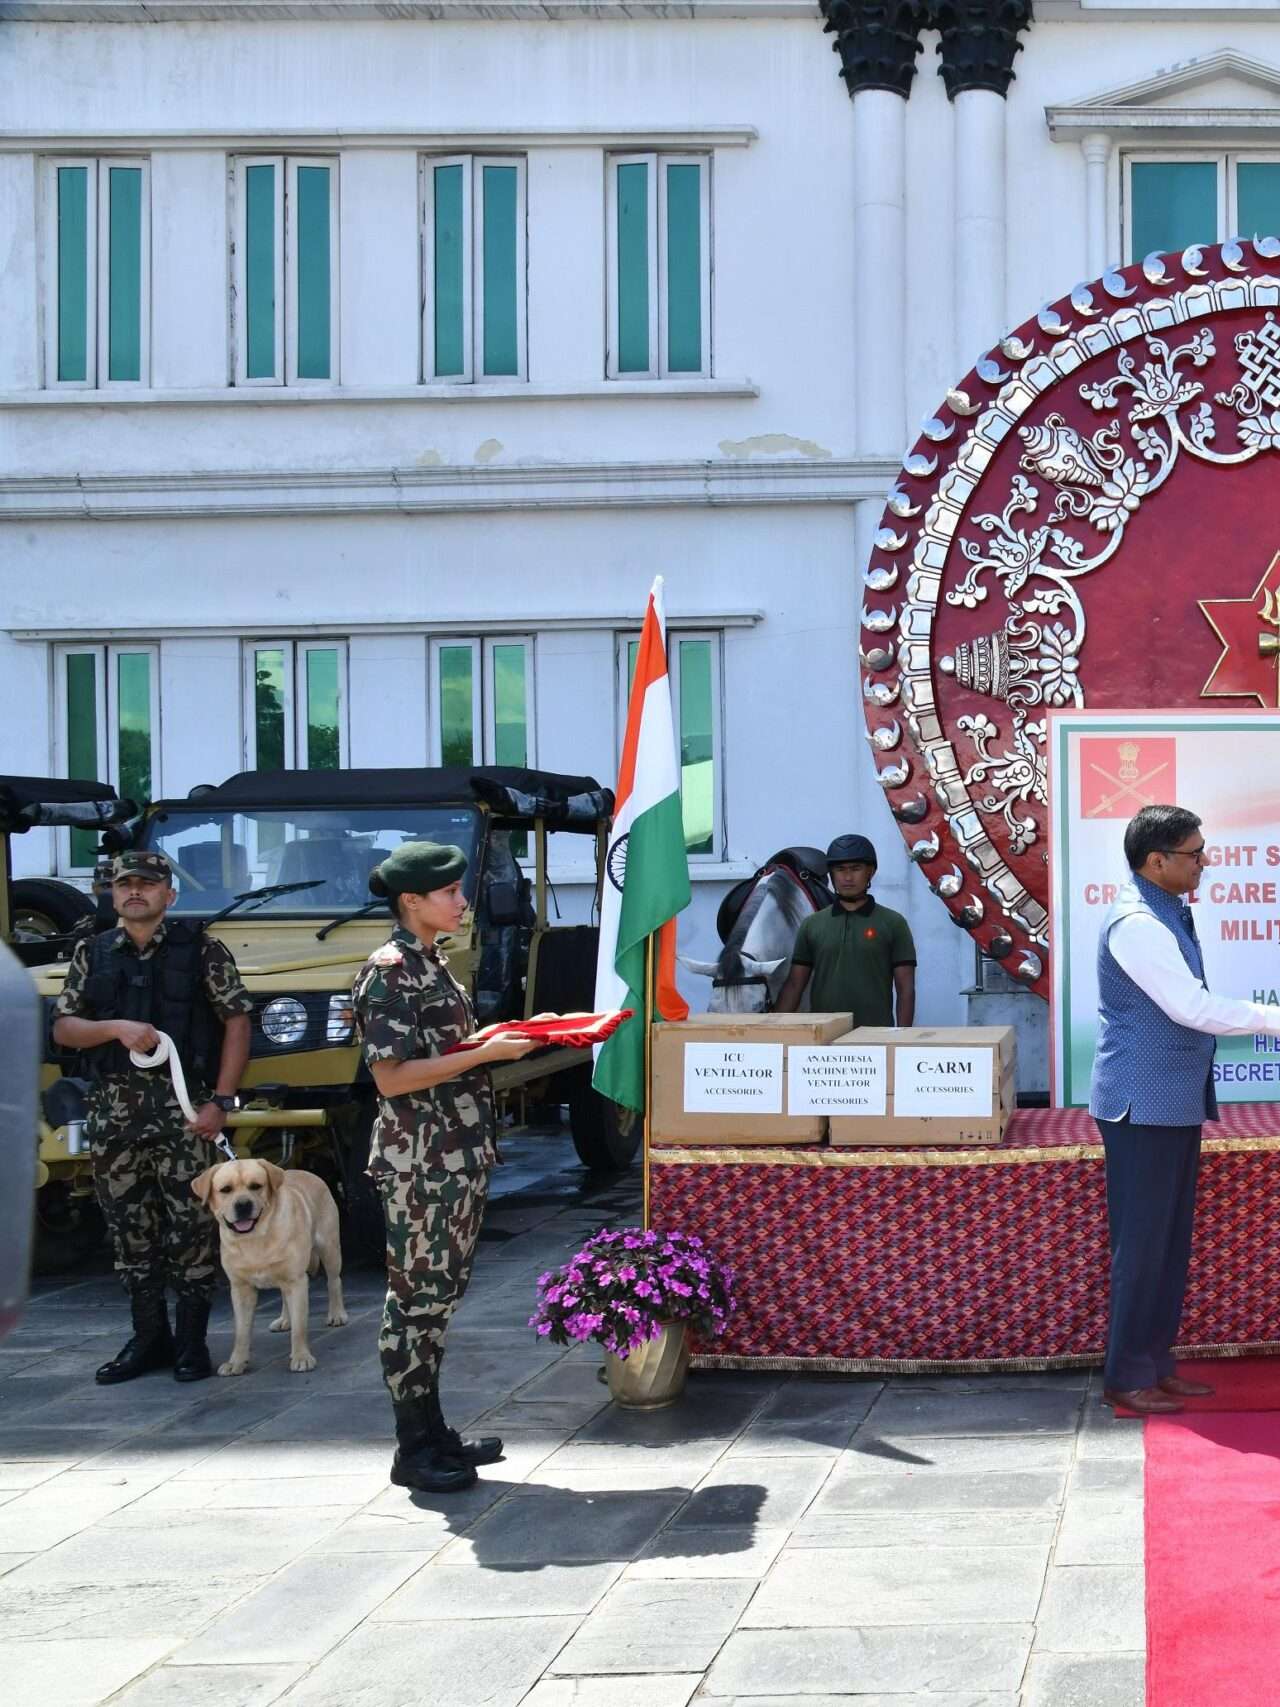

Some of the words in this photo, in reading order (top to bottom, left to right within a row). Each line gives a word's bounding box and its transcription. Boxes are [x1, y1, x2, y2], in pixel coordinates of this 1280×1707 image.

[1206, 846, 1257, 866] GHT
[1210, 882, 1276, 903] CARE
[724, 1052, 744, 1062] ICU
[807, 1055, 872, 1063] ANAESTHESIA
[802, 1067, 847, 1075] MACHINE
[851, 1067, 877, 1075] WITH
[916, 1061, 972, 1074] C-ARM
[695, 1068, 773, 1078] VENTILATOR
[808, 1079, 870, 1088] VENTILATOR
[704, 1087, 763, 1095] ACCESSORIES
[915, 1085, 974, 1093] ACCESSORIES
[809, 1097, 869, 1105] ACCESSORIES
